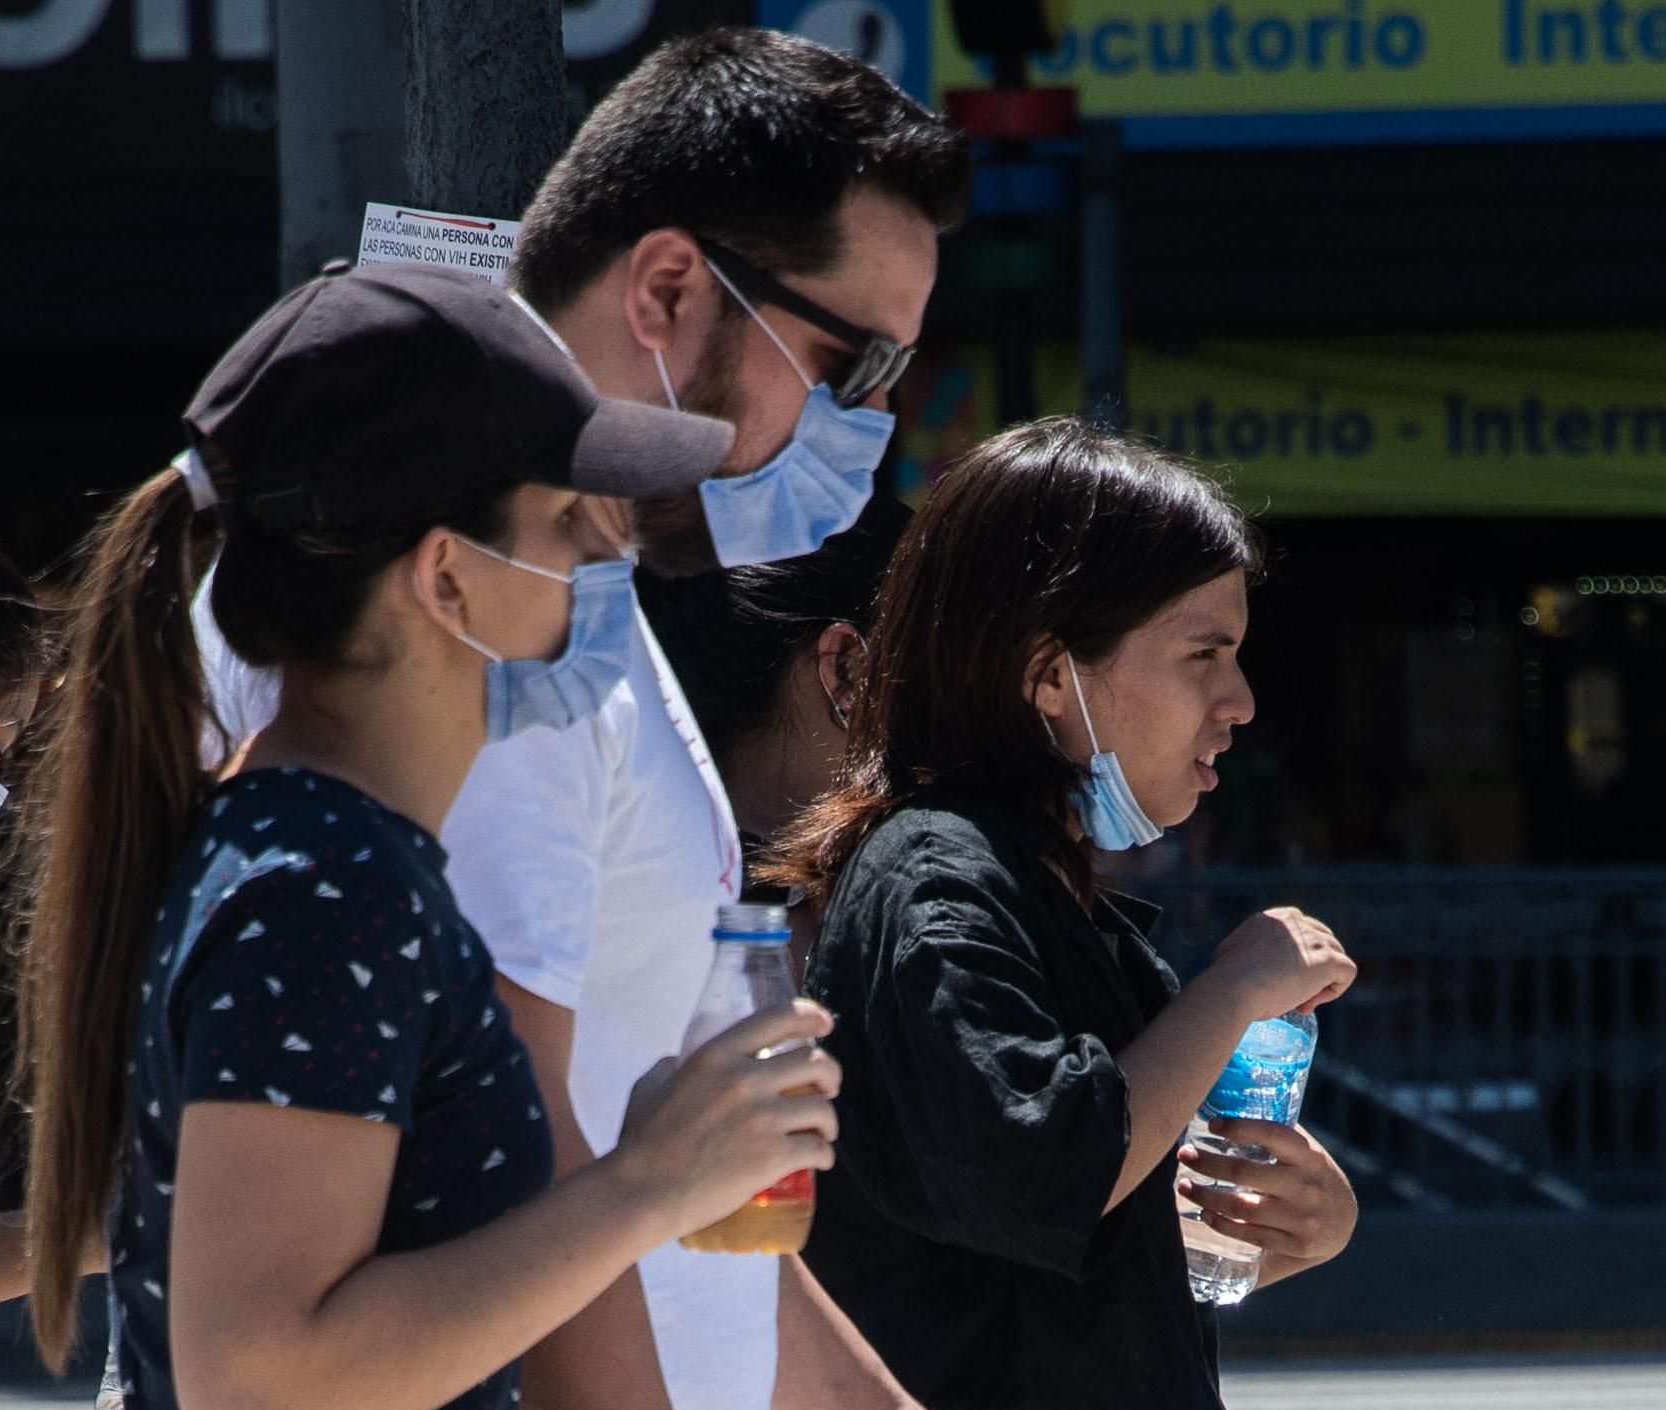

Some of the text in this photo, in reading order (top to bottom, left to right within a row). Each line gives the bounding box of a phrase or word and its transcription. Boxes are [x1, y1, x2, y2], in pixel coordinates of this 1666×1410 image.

[366, 218, 381, 232] POR
[382, 220, 395, 235] ACA
[396, 222, 422, 238] CAMINA
[422, 225, 441, 241] UNA
[442, 228, 490, 247] PERSONA
[492, 234, 514, 250] CON
[362, 238, 379, 253] LAS
[379, 240, 422, 260] PERSONAS
[424, 246, 446, 263] CON
[449, 249, 467, 266] VIH
